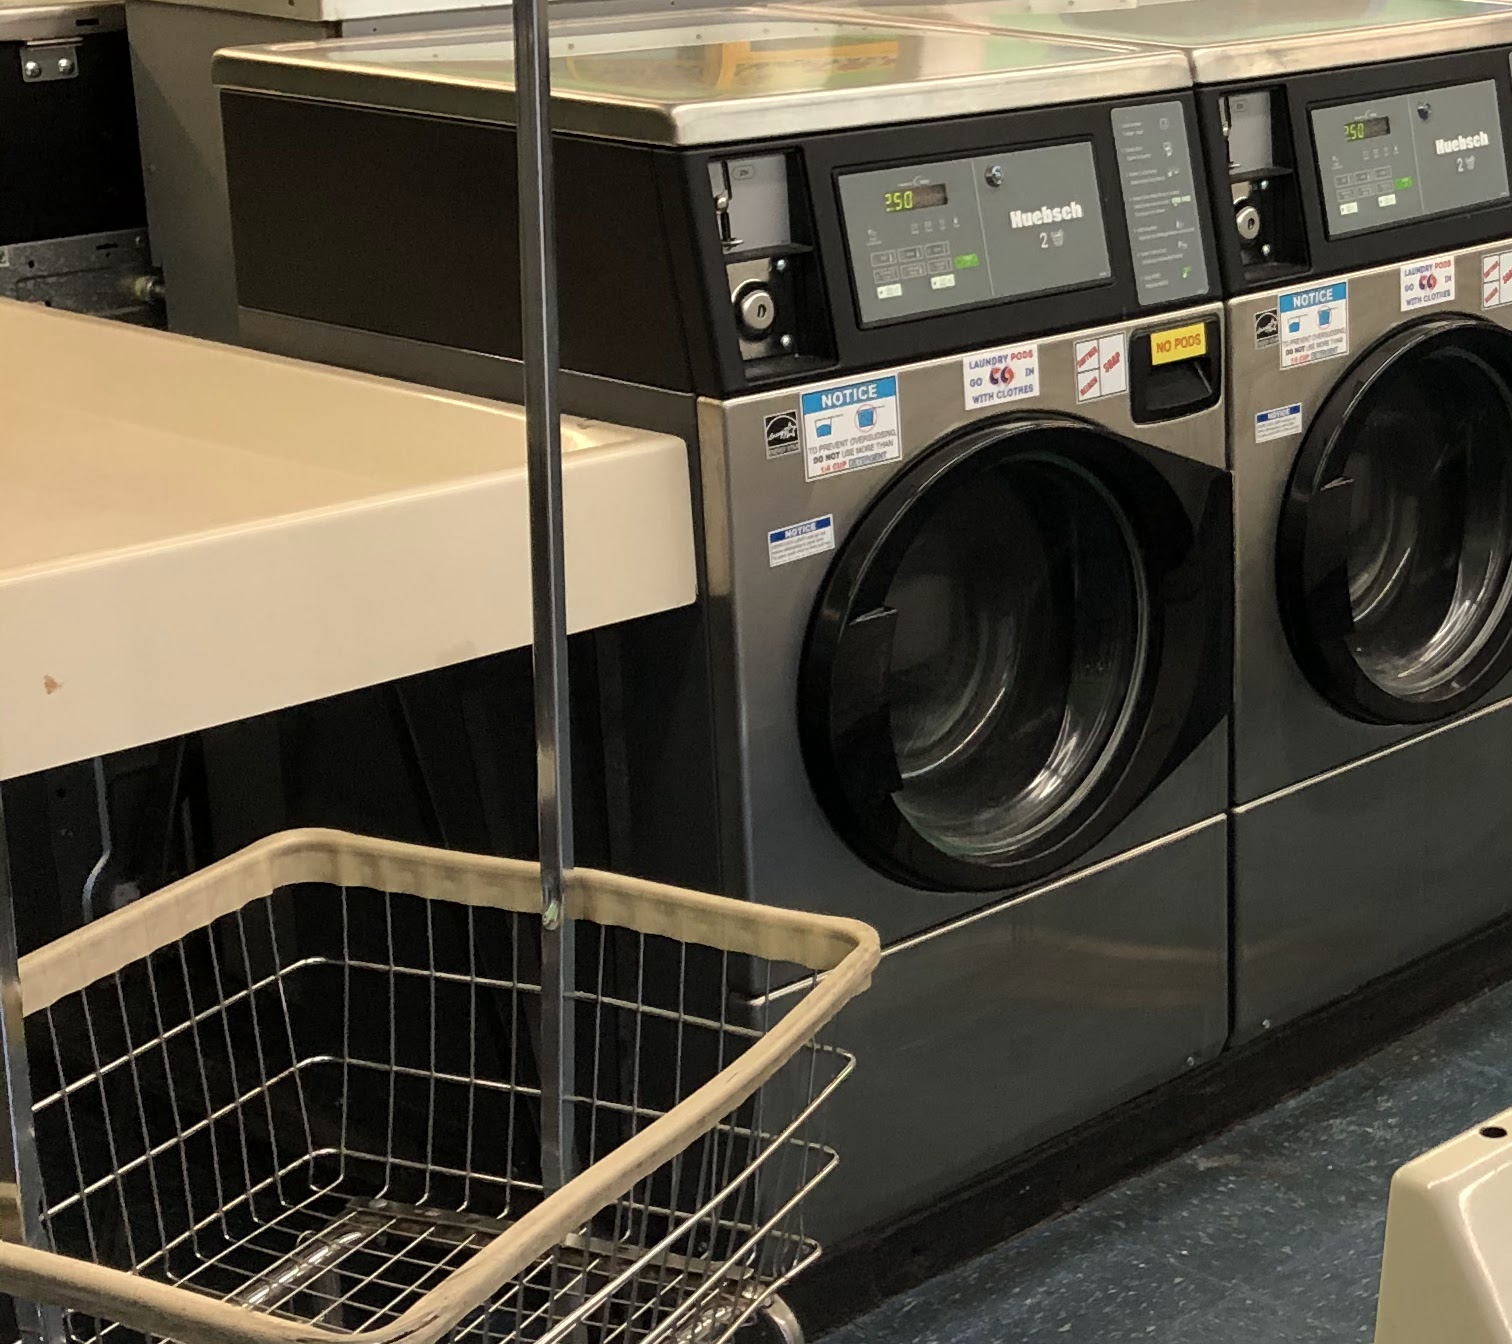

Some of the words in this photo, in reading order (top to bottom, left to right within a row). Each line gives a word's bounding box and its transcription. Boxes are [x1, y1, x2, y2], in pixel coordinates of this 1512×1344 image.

[1435, 131, 1490, 155] Huebsch
[1456, 158, 1464, 172] 2
[1010, 201, 1083, 229] Huebsch
[1039, 232, 1049, 249] 2
[1404, 263, 1433, 277] LAUNDRY
[1293, 288, 1333, 308] NOTICE
[1156, 340, 1172, 354] NO
[1174, 333, 1201, 349] PODS
[969, 354, 1009, 370] LAUNDRY
[1010, 349, 1034, 362] PODS
[969, 377, 983, 388] GO
[1025, 367, 1035, 377] IN
[821, 384, 878, 408] NOTICE
[972, 392, 995, 405] WITH
[996, 384, 1034, 400] CLOTHES
[813, 456, 824, 465] DO
[825, 452, 840, 462] NOT
[784, 522, 816, 538] NOTICE
